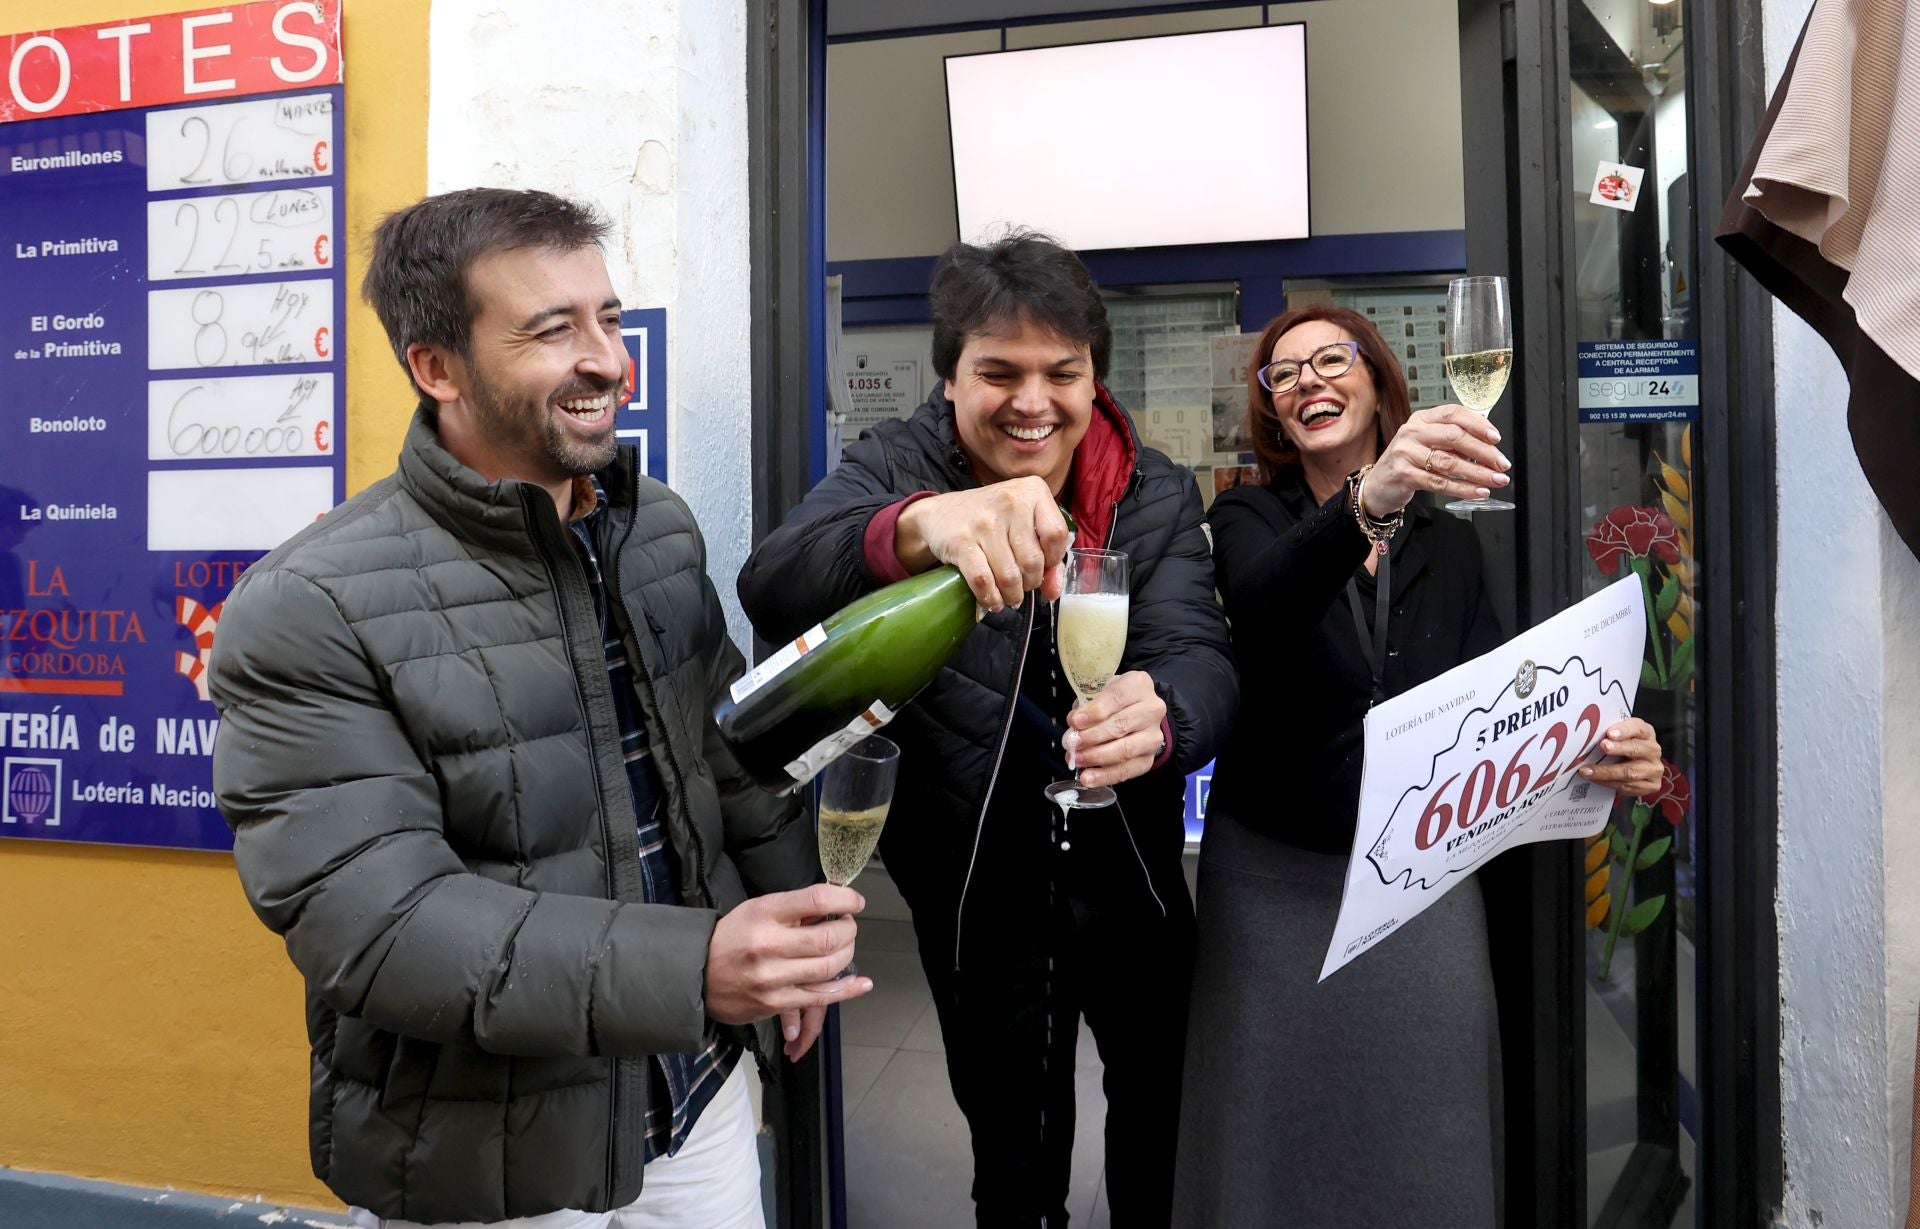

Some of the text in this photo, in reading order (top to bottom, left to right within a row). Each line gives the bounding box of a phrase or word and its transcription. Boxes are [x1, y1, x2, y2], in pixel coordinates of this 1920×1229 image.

[11, 150, 123, 172] Euromillones
[179, 116, 253, 184] 26
[313, 141, 328, 172] €
[266, 194, 319, 220] LUNES
[16, 239, 119, 258] La Primitiva
[313, 234, 329, 265] €
[31, 314, 105, 332] El Gordo
[14, 341, 122, 359] de la Primitiva
[313, 326, 329, 358] €
[1579, 349, 1695, 359] CONECTADO PERMANENTEMENTE
[1595, 343, 1625, 351] SISTEMA
[1637, 341, 1678, 350] SEGURIDAD
[1602, 359, 1634, 367] CENTRAL
[1636, 358, 1679, 366] RECEPTORA
[884, 377, 892, 390] €
[30, 417, 107, 433] Bonoloto
[1629, 411, 1686, 419] www.segur24.es
[313, 420, 329, 451] €
[20, 503, 118, 520] La Quiniela
[27, 560, 70, 597] LA
[174, 561, 256, 588] LOTE
[1591, 624, 1600, 634] DE
[1600, 605, 1632, 630] DICIEMBRE
[5, 647, 126, 676] CÓRDOBA
[1385, 690, 1476, 741] LOTERÍA DE NAVIDAD
[1492, 686, 1569, 743] PREMIO
[99, 716, 136, 753] de
[1415, 703, 1601, 851] 60622
[72, 780, 144, 804] Lotería
[1446, 806, 1515, 852] VENDIDO
